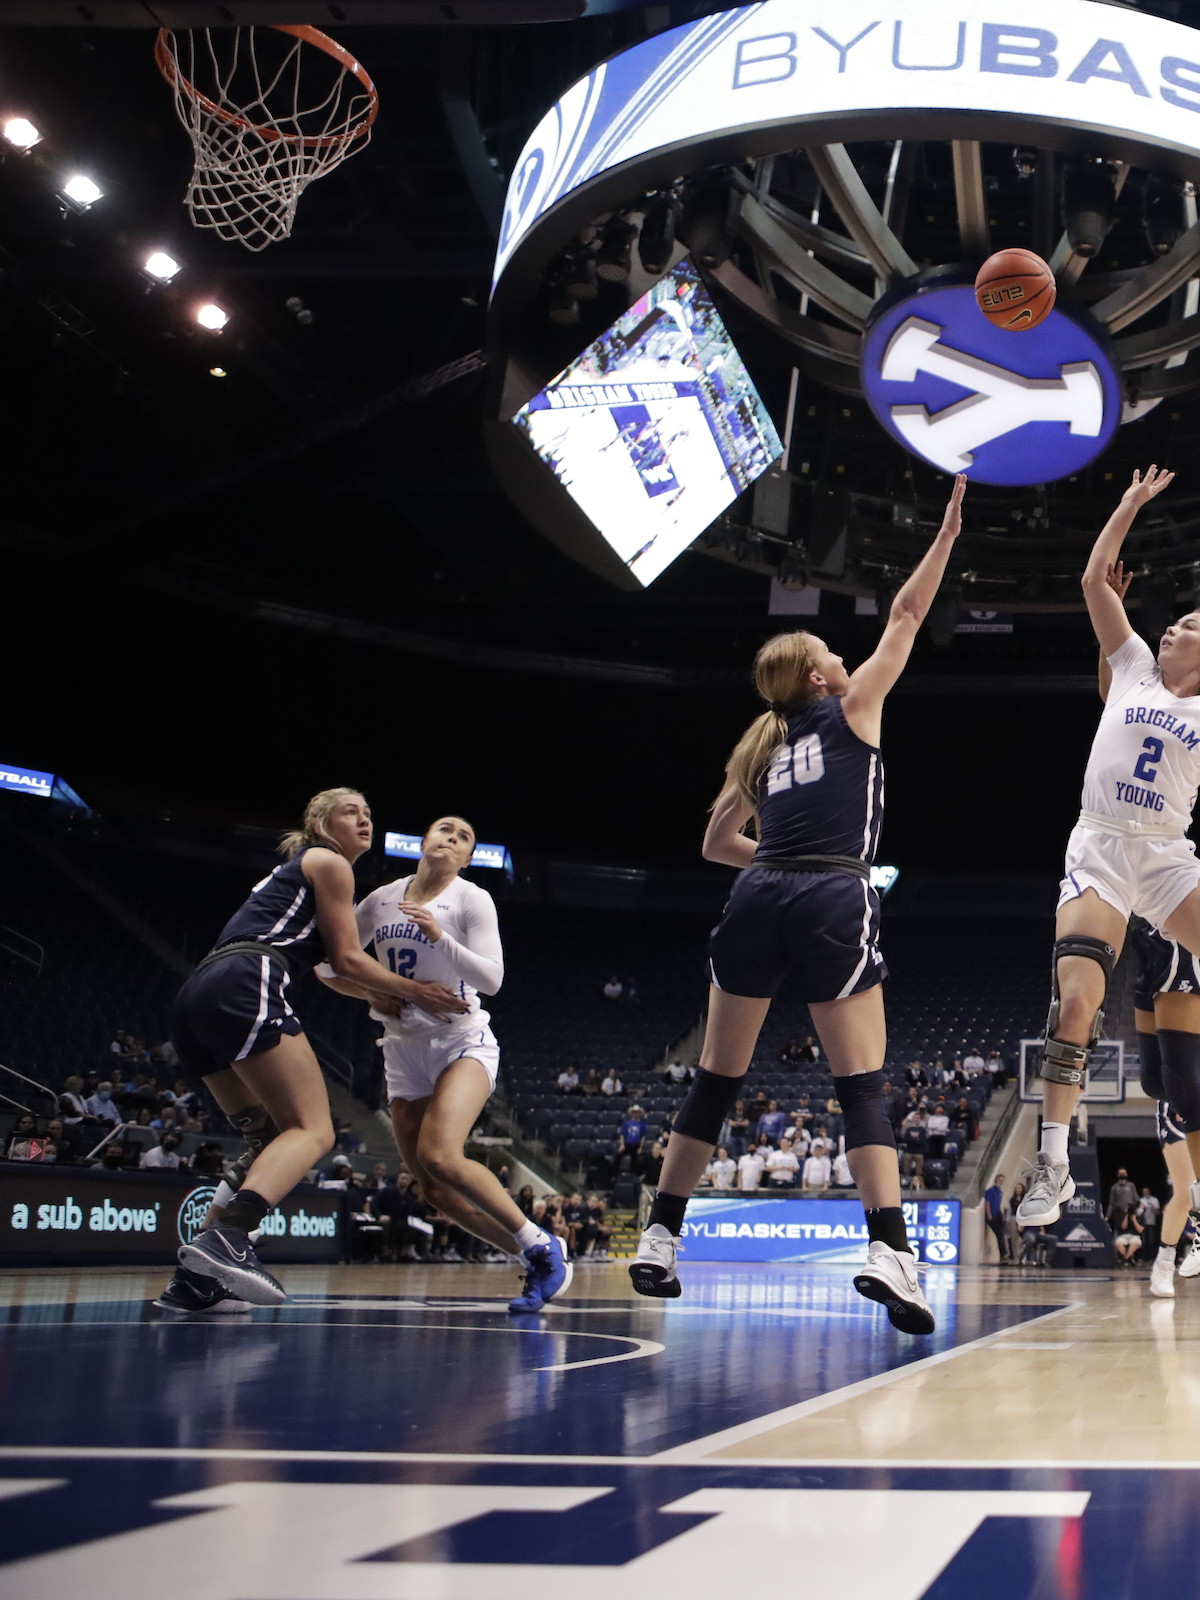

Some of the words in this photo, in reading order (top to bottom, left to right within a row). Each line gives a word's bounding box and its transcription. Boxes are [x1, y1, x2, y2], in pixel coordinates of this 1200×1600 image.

[631, 382, 678, 402] YOUNG
[1125, 706, 1200, 752] BRIGHAM
[767, 733, 826, 797] 20
[1133, 736, 1165, 783] 2
[1116, 781, 1165, 812] YOUNG
[387, 947, 418, 980] 12
[11, 1202, 29, 1230] a
[37, 1196, 83, 1232] sub
[259, 1207, 287, 1236] sub
[902, 1202, 919, 1226] 21
[927, 1225, 950, 1241] 6:35
